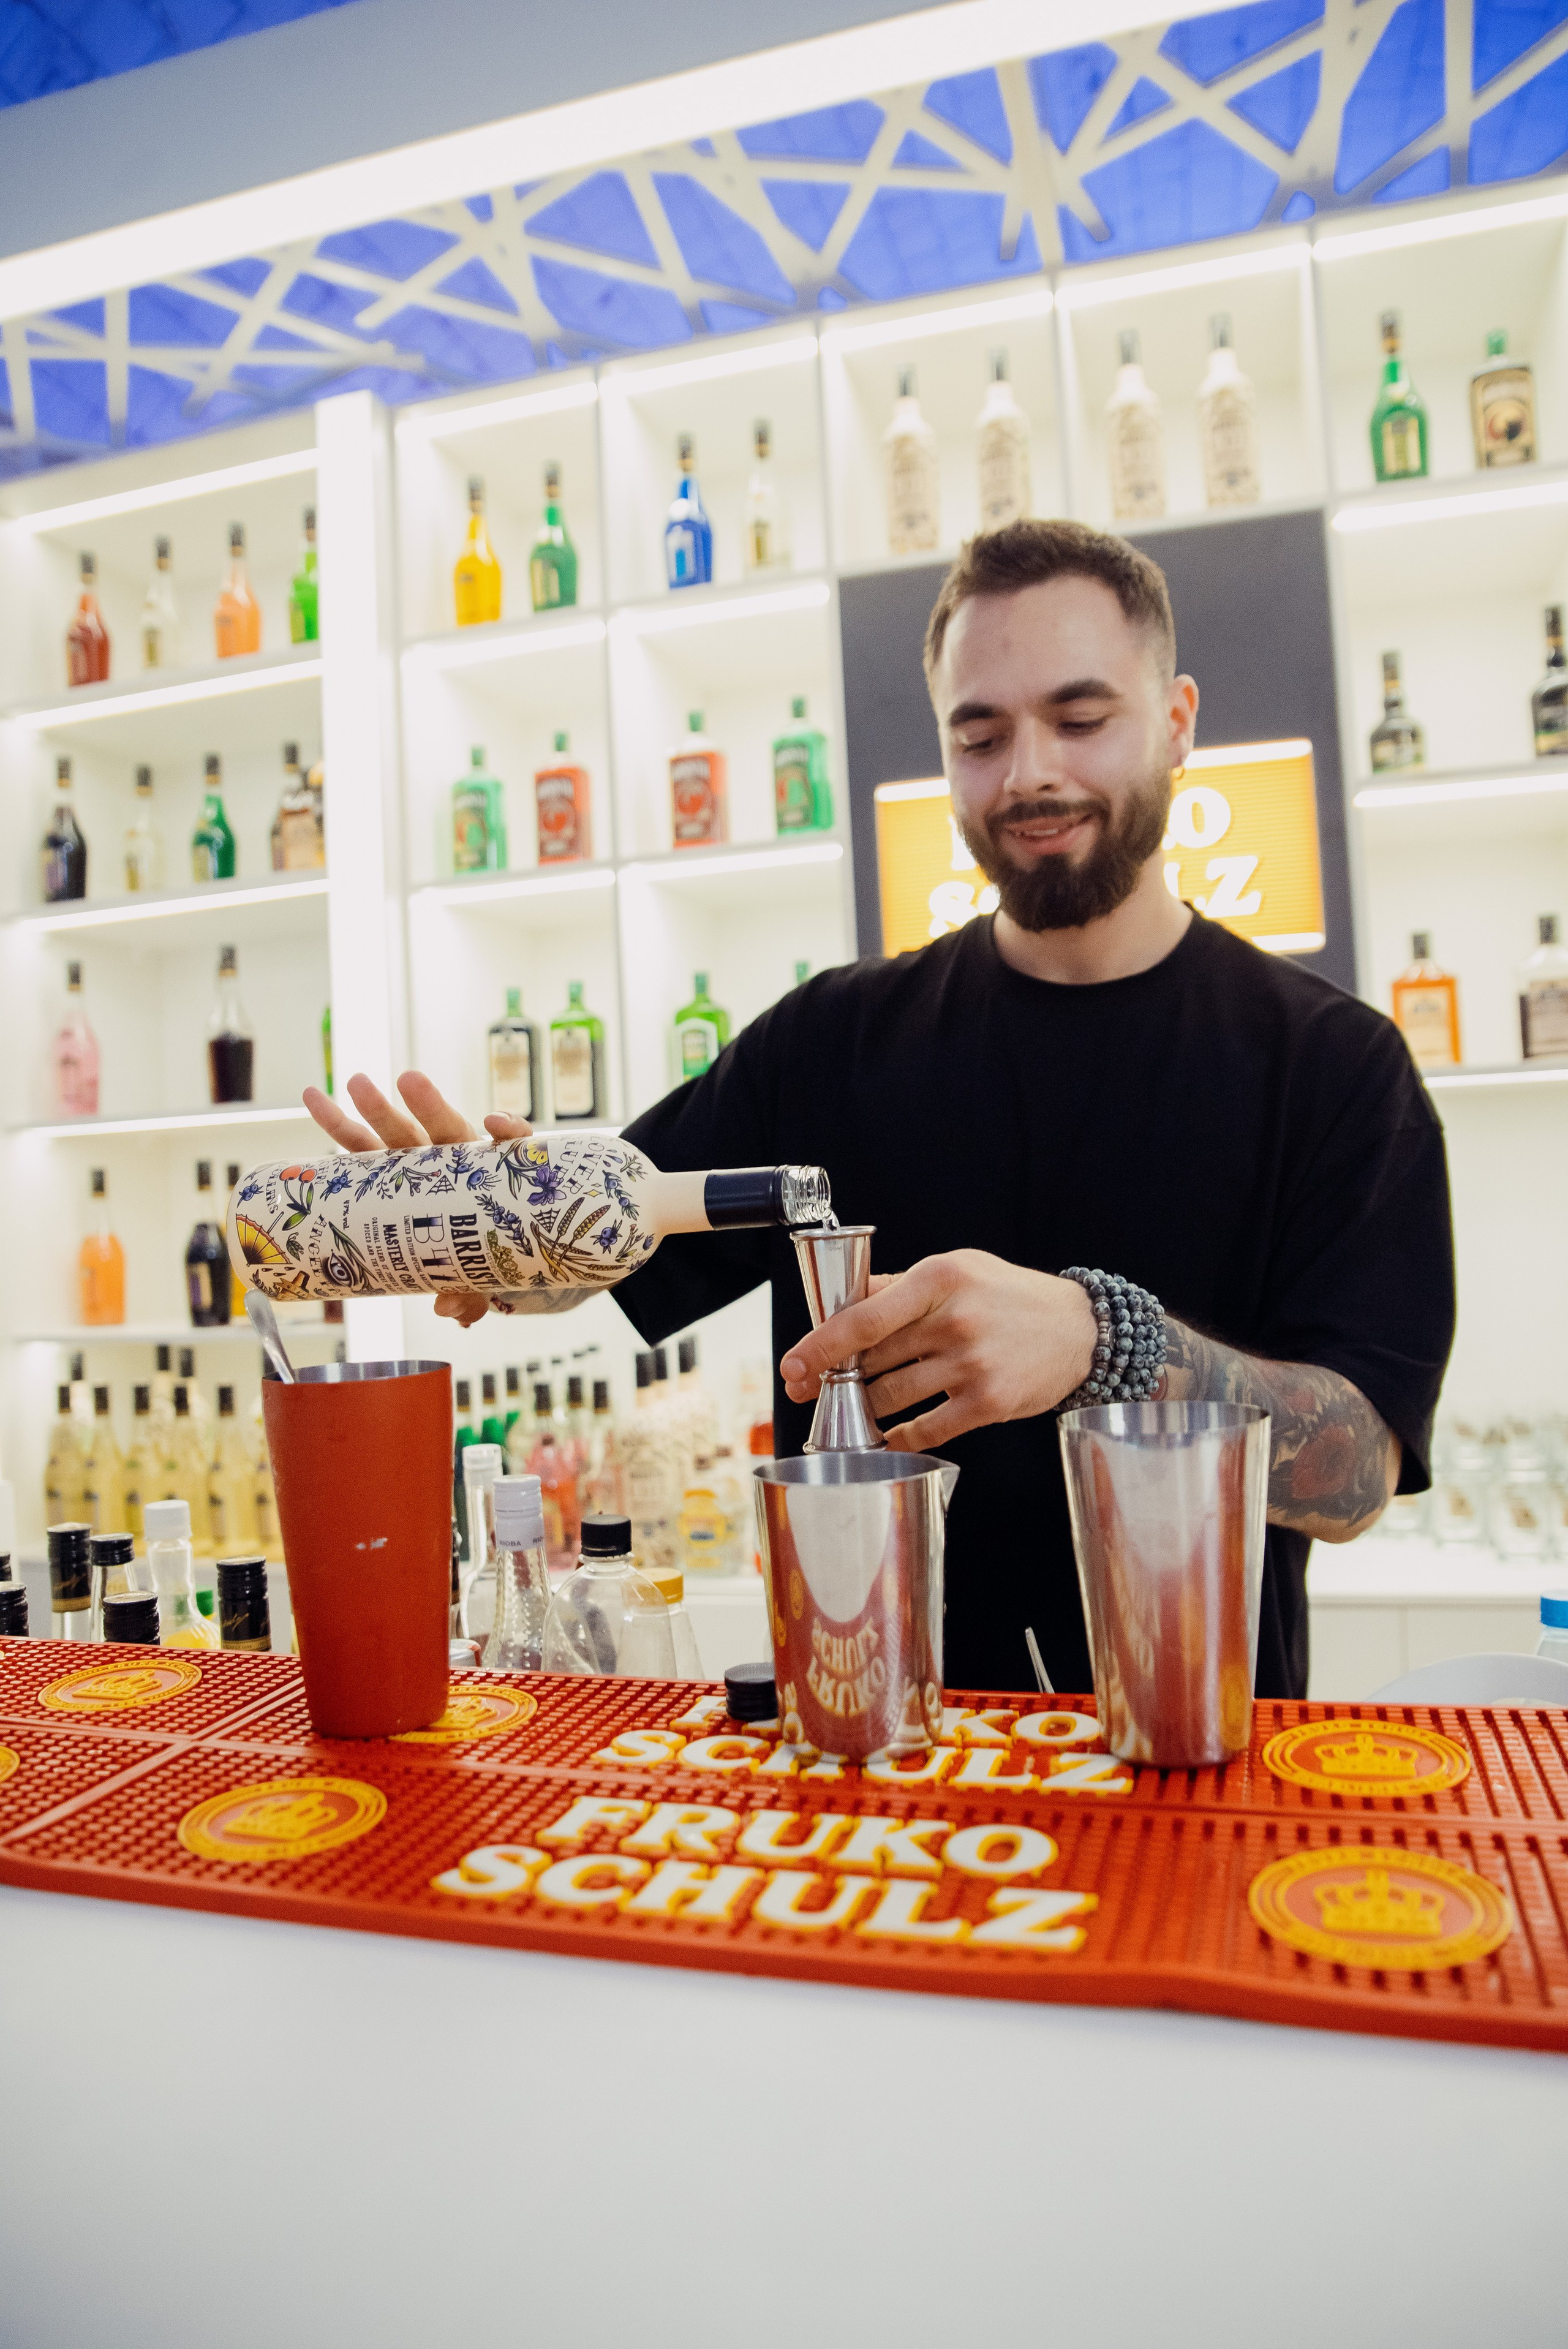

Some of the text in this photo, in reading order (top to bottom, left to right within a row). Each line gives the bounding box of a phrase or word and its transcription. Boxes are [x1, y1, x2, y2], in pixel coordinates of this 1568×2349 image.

[372, 1216, 380, 1244] ORIGINAL
[383, 1224, 410, 1272] MASTERLY
[406, 1237, 415, 1256] EDITION
[449, 1213, 505, 1291] BARRIST
[536, 1795, 1059, 1880] FRUKO
[431, 1844, 1099, 1953] SCHULZ
